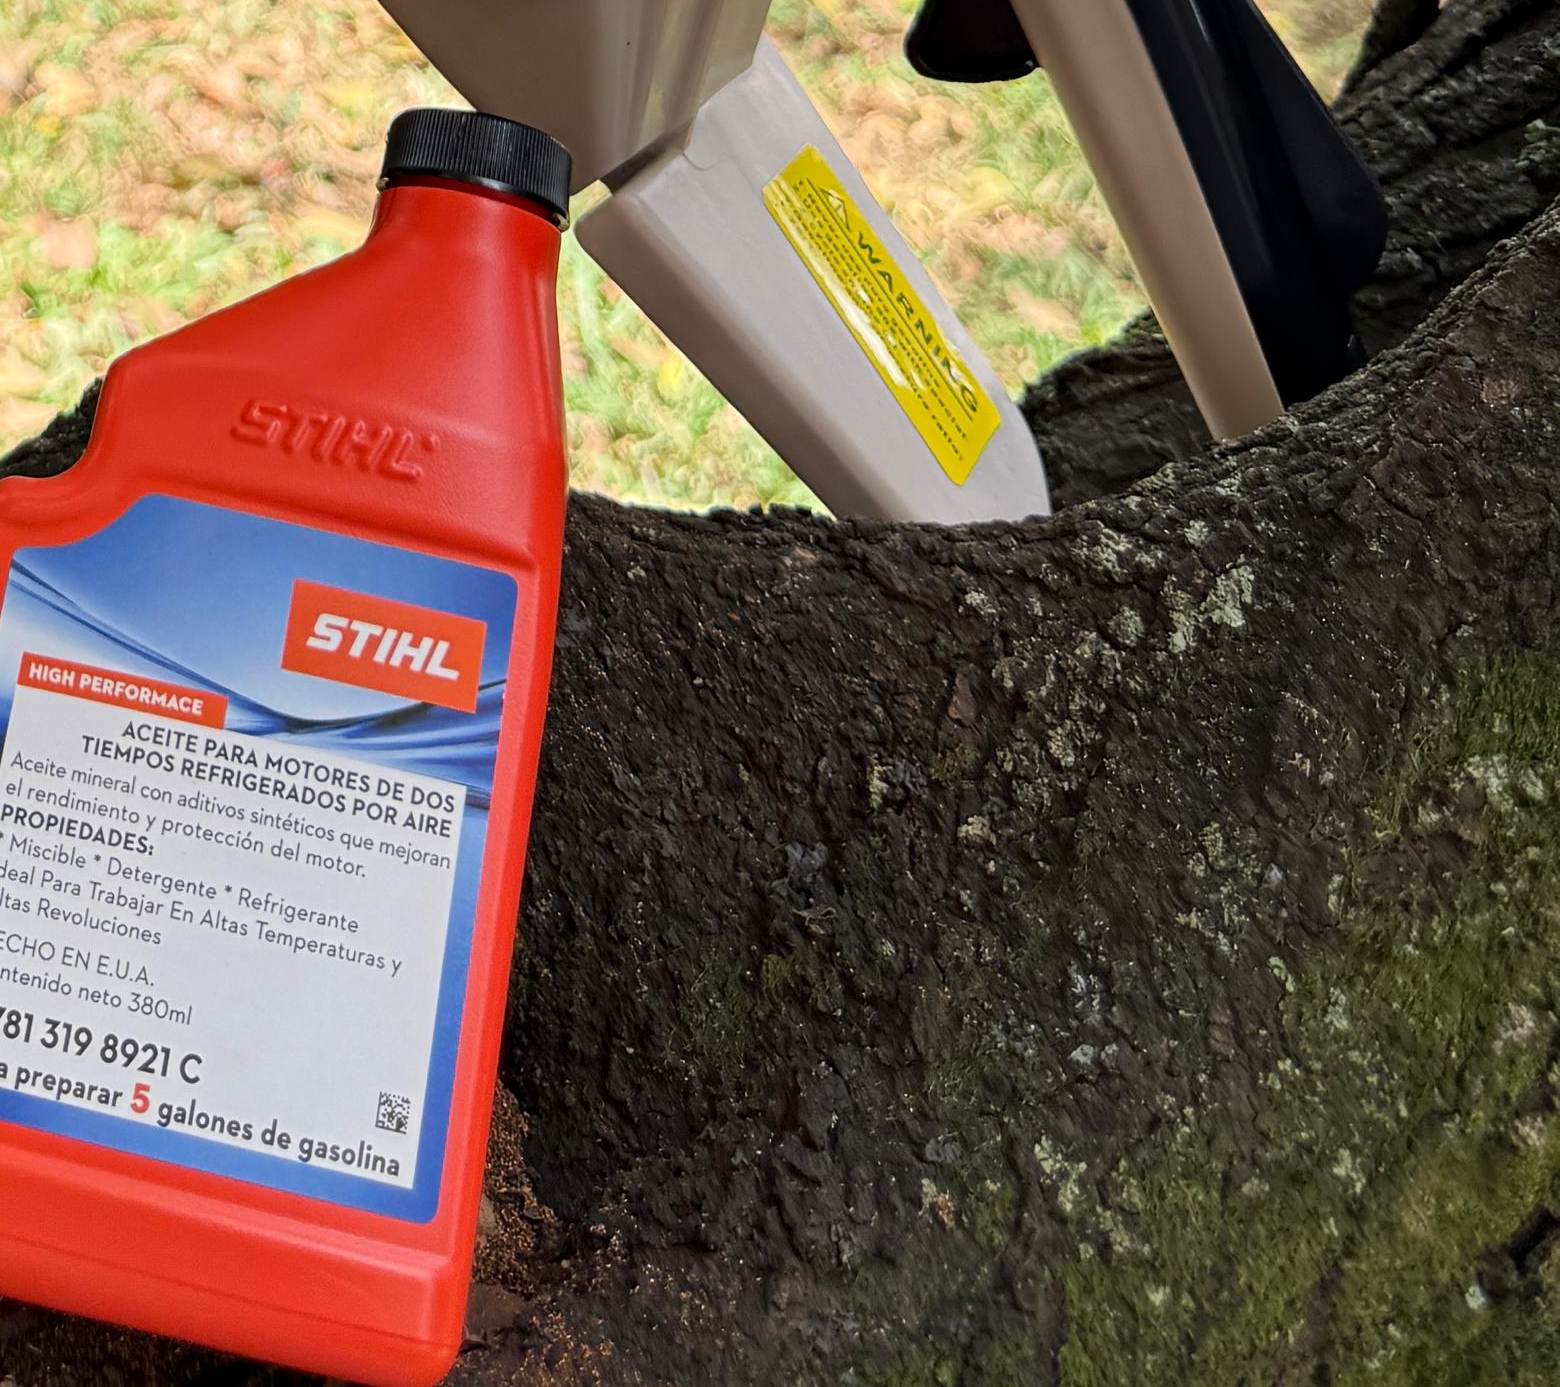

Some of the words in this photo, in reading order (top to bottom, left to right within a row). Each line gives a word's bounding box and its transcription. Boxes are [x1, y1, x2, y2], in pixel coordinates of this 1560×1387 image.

[857, 231, 978, 414] WARNING
[231, 398, 423, 484] STIHL
[29, 662, 75, 687] HIGH
[79, 673, 203, 715] PERFORMACE
[306, 611, 461, 681] STIHL
[10, 751, 67, 779] Aceite
[71, 767, 137, 795] mineral
[140, 785, 173, 804] con
[177, 790, 245, 821] aditivos
[249, 807, 335, 842] sintéticos
[339, 832, 374, 851] que
[379, 841, 450, 869] mejoran
[81, 734, 175, 773] TIEMPOS
[180, 757, 346, 813] REFRIGERADOS
[351, 797, 398, 826] POR
[402, 811, 452, 839] AIRE
[121, 720, 199, 754] ACEITE
[203, 738, 258, 768] PARA
[264, 752, 371, 793] MOTORES
[376, 778, 405, 802] DE
[410, 786, 455, 813] DOS
[0, 803, 154, 857] PROPIEDADES:
[5, 777, 23, 797] el
[27, 787, 140, 824] rendimiento
[145, 814, 157, 832] y
[161, 819, 264, 854] protección
[270, 838, 301, 862] del
[305, 852, 366, 878] motor.
[9, 833, 87, 869] Miscible
[107, 856, 217, 900] Detergente
[238, 887, 359, 933] Refrigerante
[37, 897, 161, 945] Revoluciones
[40, 869, 81, 897] Para
[89, 880, 165, 917] Trabajar
[169, 900, 194, 924] En
[199, 909, 248, 936] Altas
[255, 919, 385, 970] Temperaturas
[391, 959, 402, 978] y
[61, 946, 91, 971] EN
[96, 954, 154, 987] E.U.A.
[78, 986, 122, 1008] neto
[127, 991, 193, 1026] 380ml
[39, 1017, 93, 1057] 319
[99, 1033, 171, 1078] 8921
[179, 1053, 203, 1085] C
[14, 1066, 124, 1108] preparar
[130, 1082, 151, 1115] 5
[156, 1098, 254, 1141] galones
[260, 1118, 292, 1150] de
[297, 1137, 400, 1177] gasolina
